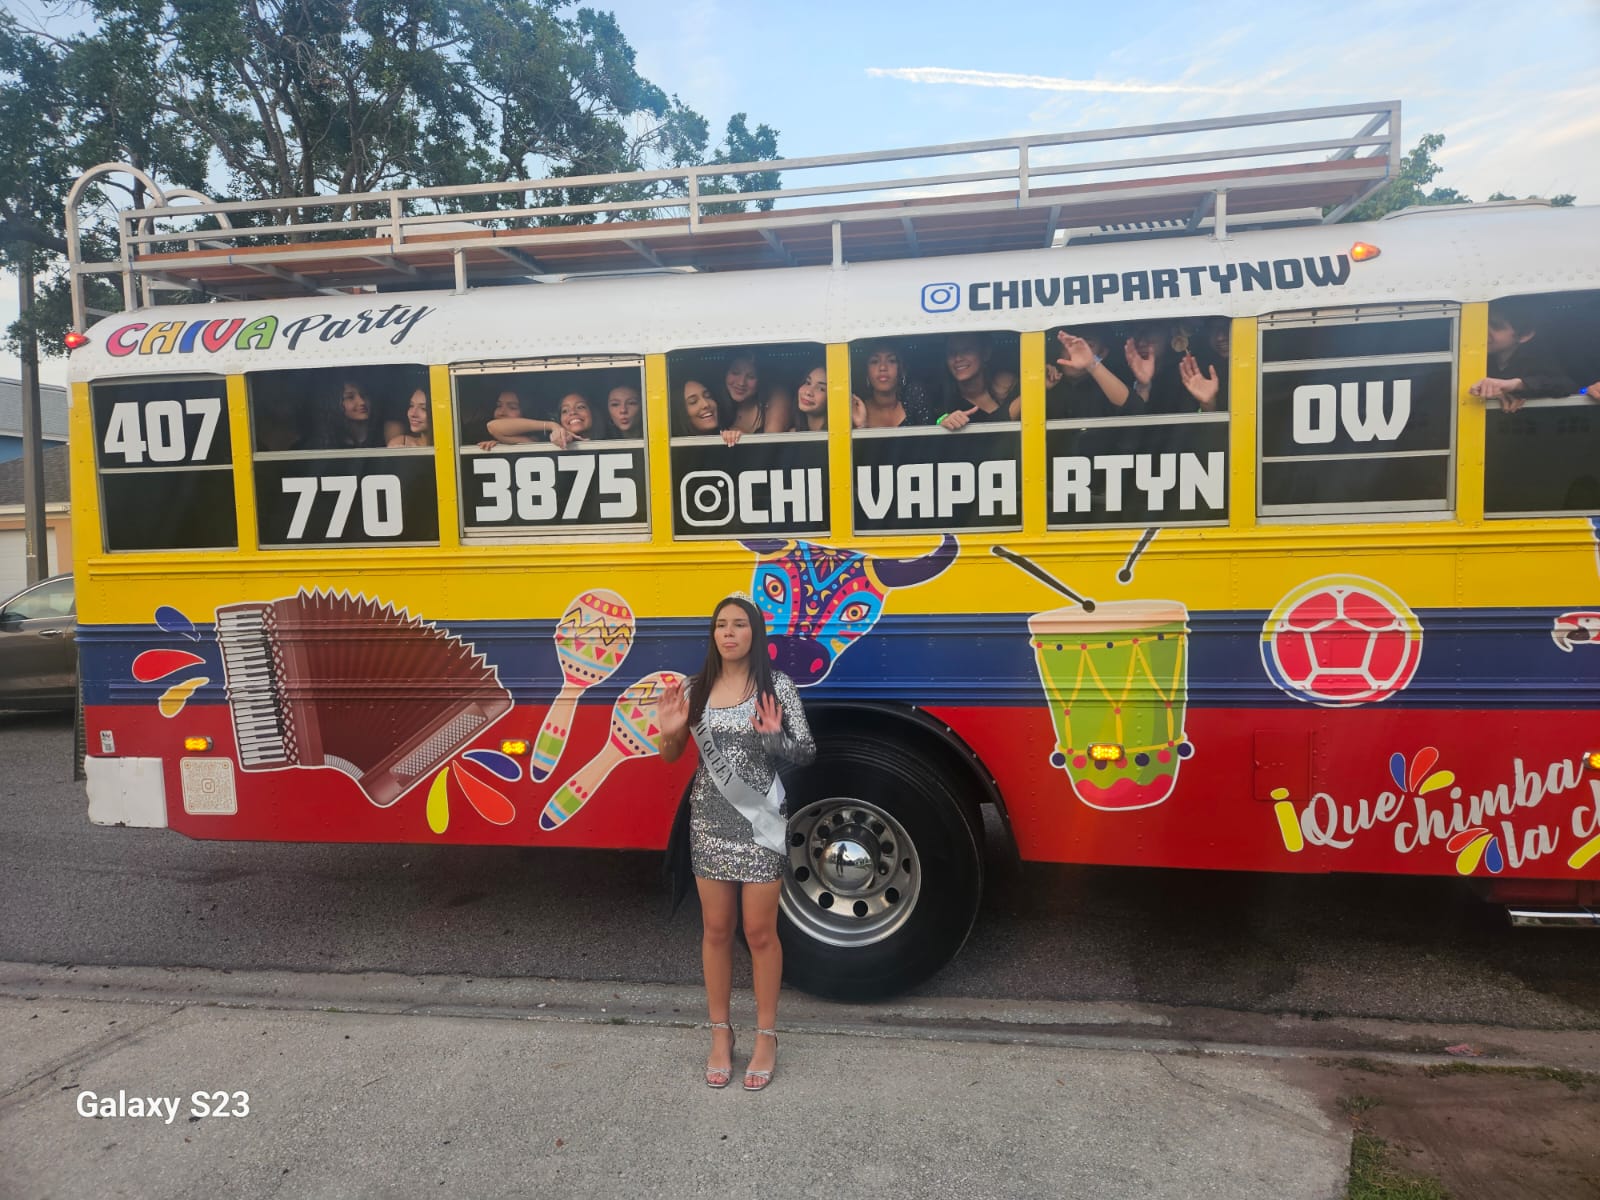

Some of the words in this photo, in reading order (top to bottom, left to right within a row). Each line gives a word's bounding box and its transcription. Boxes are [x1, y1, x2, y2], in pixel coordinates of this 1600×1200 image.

[968, 254, 1351, 312] CHIVAPARTYNOW
[106, 315, 278, 357] CHIVA
[283, 304, 437, 351] Party
[104, 398, 222, 464] 407
[281, 474, 404, 540] 770
[473, 453, 638, 523] 3875
[738, 467, 823, 525] CHI
[857, 459, 1018, 521] VAPA
[1052, 451, 1225, 513] RTYN
[1292, 379, 1412, 445] OW
[703, 740, 733, 786] QUEEN
[1393, 757, 1585, 854] chimba
[1500, 821, 1560, 869] la
